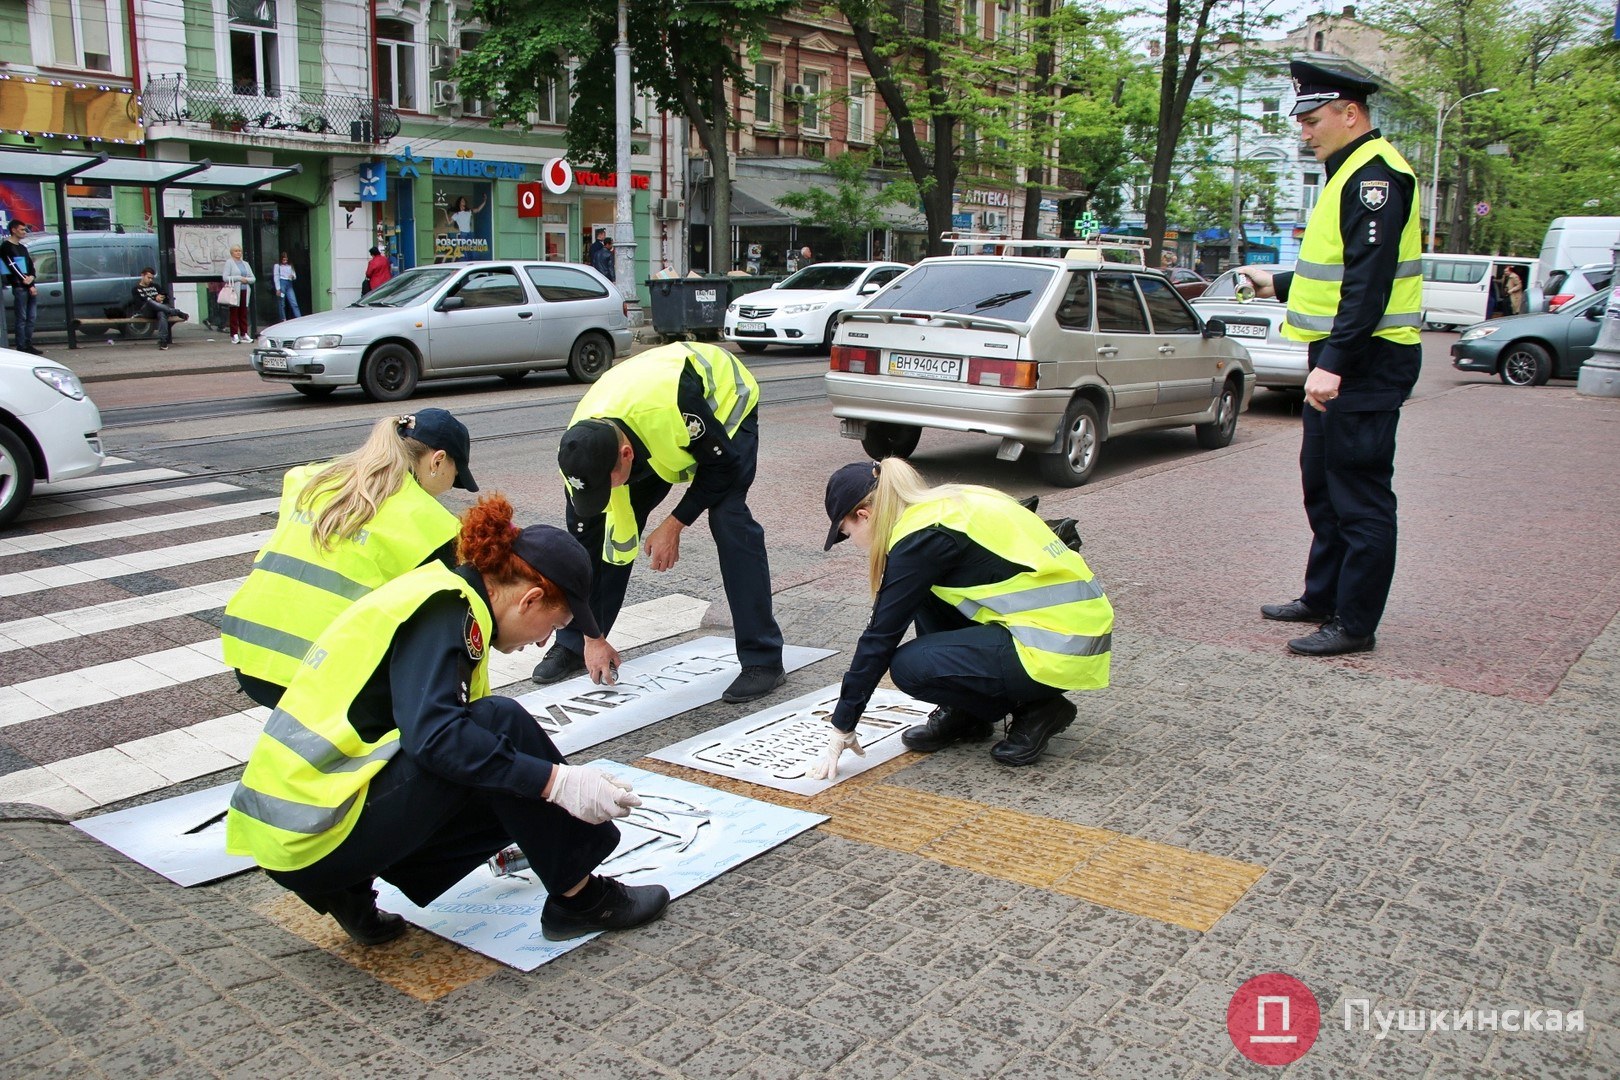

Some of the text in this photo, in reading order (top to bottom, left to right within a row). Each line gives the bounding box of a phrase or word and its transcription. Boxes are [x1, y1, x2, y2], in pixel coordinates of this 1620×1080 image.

[433, 149, 526, 179] КИЇВСТАР
[575, 170, 650, 190] vodane
[965, 190, 1009, 206] АПТЕКА
[435, 239, 488, 247] РОЗСТРОЧКА
[445, 246, 464, 258] 24
[1231, 326, 1250, 334] 3345
[1252, 327, 1265, 335] BM
[896, 356, 956, 373] BH 9404 CP
